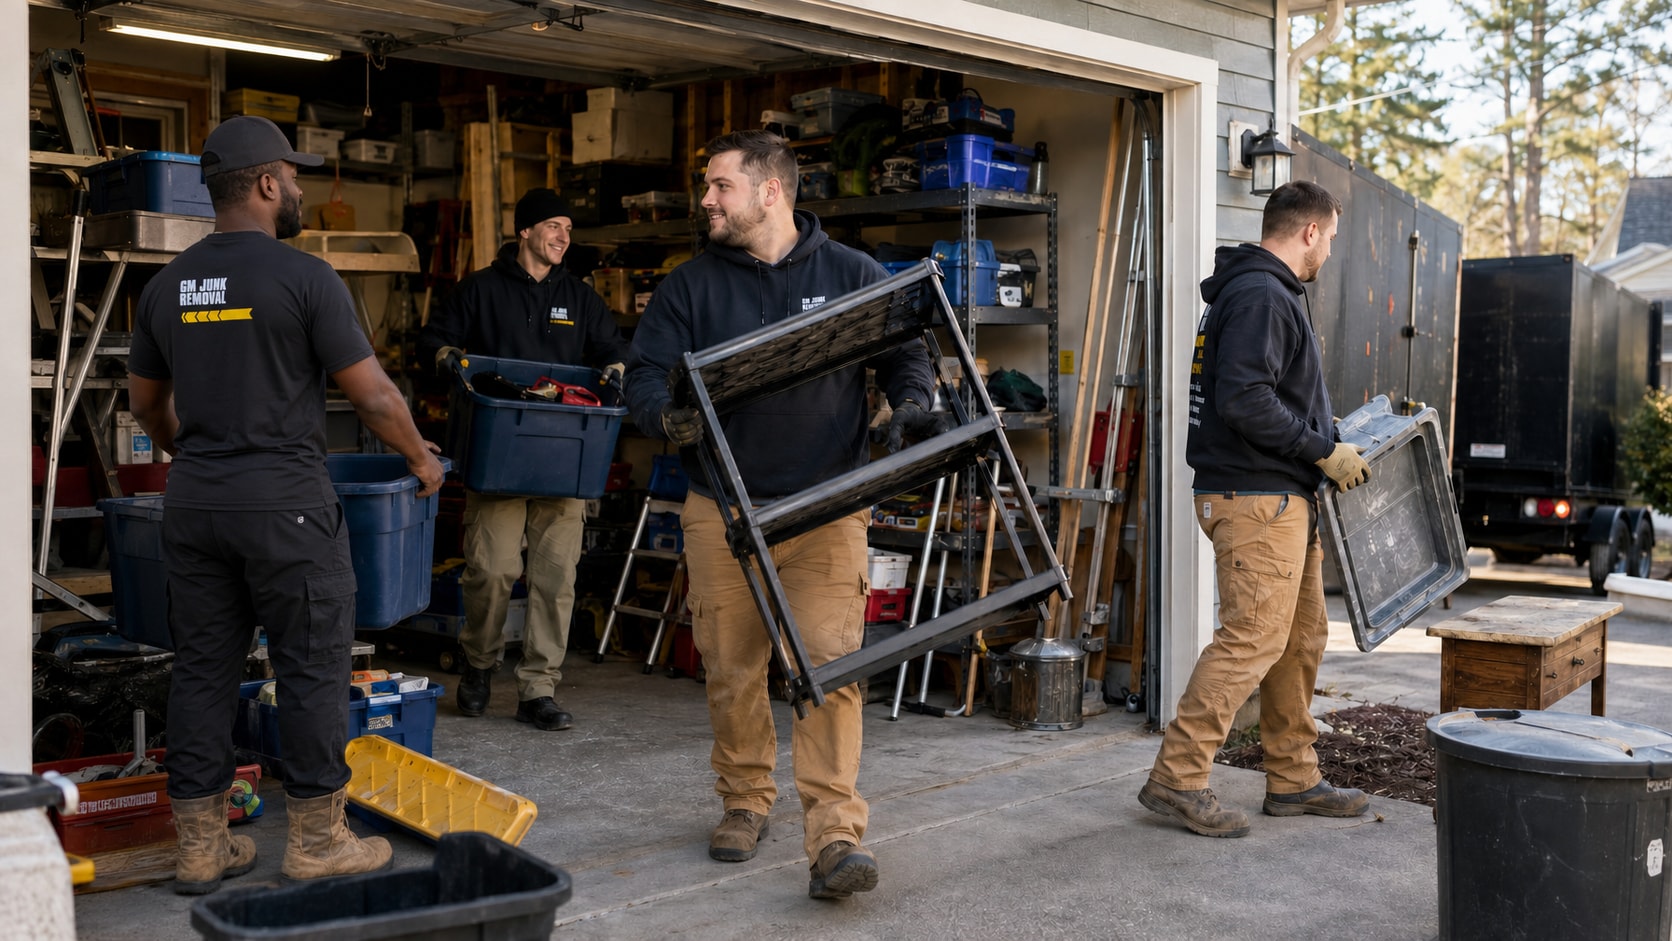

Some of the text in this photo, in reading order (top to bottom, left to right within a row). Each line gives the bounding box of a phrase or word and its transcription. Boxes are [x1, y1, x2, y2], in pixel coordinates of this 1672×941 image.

[180, 277, 227, 293] GM JUNK
[179, 290, 227, 306] REMOVAL
